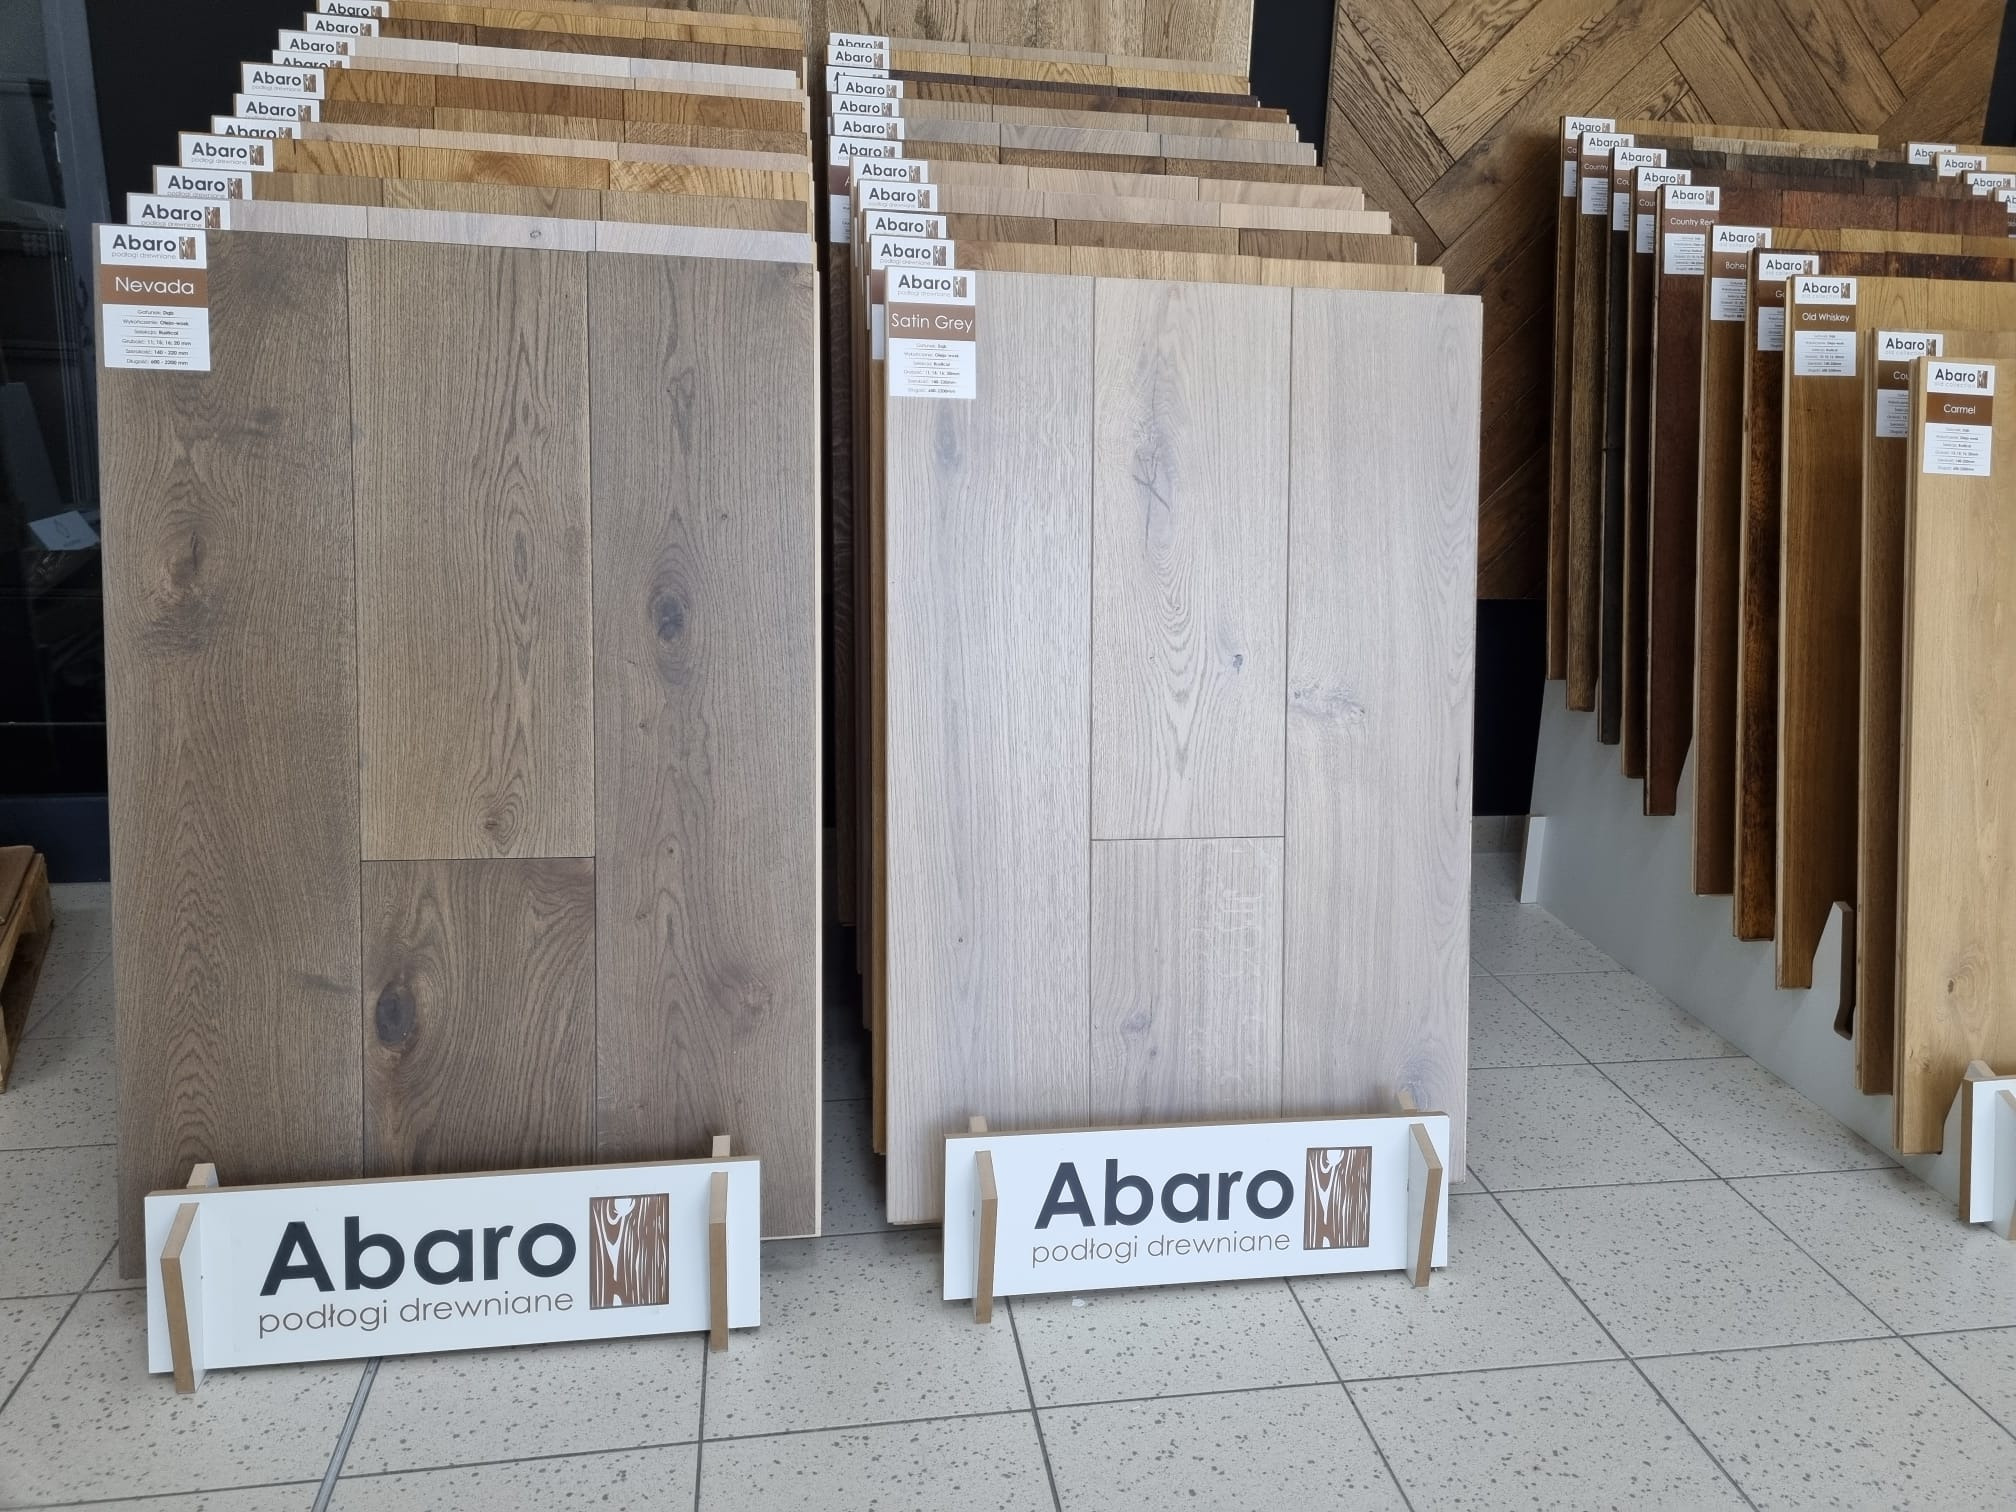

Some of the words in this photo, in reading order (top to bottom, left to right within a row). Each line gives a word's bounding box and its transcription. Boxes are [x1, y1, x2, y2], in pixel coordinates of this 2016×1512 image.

[327, 3, 370, 16] Abaro
[315, 20, 359, 34] Abaro
[289, 38, 335, 53] Abaro
[838, 38, 873, 48] Abaro
[836, 51, 872, 63] Abaro
[252, 71, 302, 86] Abaro
[846, 82, 885, 95] Abaro
[246, 101, 296, 117] Abaro
[840, 100, 880, 114] Abaro
[225, 125, 276, 138] Abaro
[843, 121, 885, 134] Abaro
[1571, 122, 1601, 132] Abaro
[1589, 138, 1619, 147] Abaro
[192, 142, 247, 159] Abaro
[838, 143, 882, 157] Abaro
[1621, 152, 1652, 162] Abaro
[862, 163, 907, 178] Abaro
[1945, 159, 1974, 169] Abaro
[168, 175, 226, 192] Abaro
[1644, 173, 1676, 183] Abaro
[1973, 178, 2002, 187] Abaro
[869, 187, 916, 202] Abaro
[1671, 190, 1704, 200] Abaro
[141, 203, 203, 221] Abaro
[876, 217, 924, 233] Abaro
[1670, 218, 1699, 227] Country
[112, 234, 177, 252] Abaro
[1720, 231, 1755, 243] Abaro
[880, 243, 931, 259] Abaro
[1766, 259, 1802, 271] Abaro
[115, 276, 194, 294] Nevada
[898, 274, 951, 290] Abaro
[1802, 282, 1840, 294] Abaro
[891, 313, 930, 329] Satin
[935, 315, 973, 333] Grey
[1802, 312, 1817, 321] Old
[1818, 313, 1850, 323] Whiskey
[1886, 338, 1925, 350] Abaro
[1935, 368, 1976, 382] Abaro
[1943, 403, 1976, 414] Carmel
[1034, 1158, 1294, 1230] Abaro
[260, 1215, 577, 1297] Abaro
[1032, 1235, 1138, 1268] podłogi
[1148, 1230, 1291, 1257] drewniane
[259, 1299, 388, 1339] podłogi
[399, 1290, 574, 1323] drewniane
